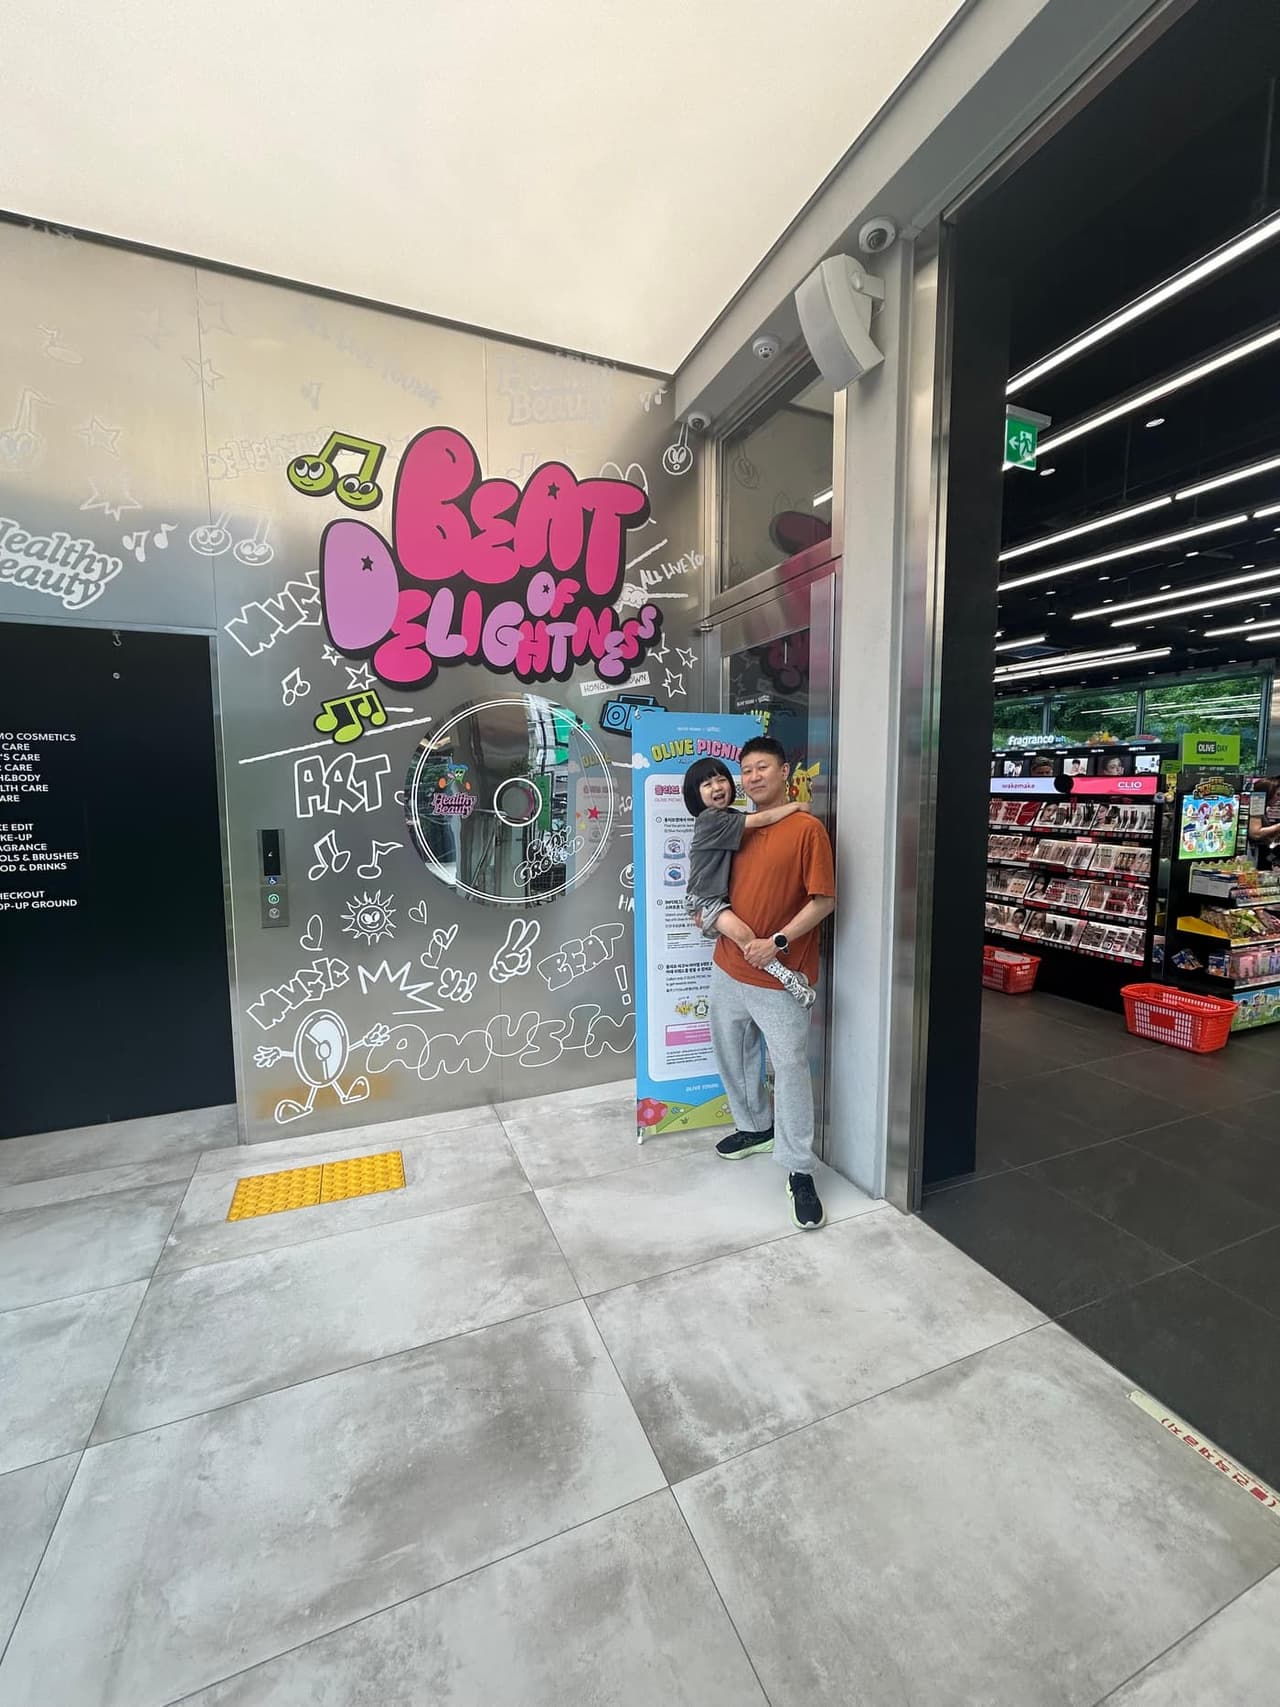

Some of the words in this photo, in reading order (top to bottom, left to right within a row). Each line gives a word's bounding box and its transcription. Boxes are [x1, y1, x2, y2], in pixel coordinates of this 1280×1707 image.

[396, 428, 649, 598] BEAT
[661, 557, 688, 579] LIVE
[526, 571, 581, 618] OF
[322, 519, 661, 685] DELIGHTNESS
[224, 570, 321, 656] MUS
[16, 732, 77, 742] COSMETICS
[651, 737, 694, 763] OLIVE
[1198, 743, 1216, 752] OLIVE
[12, 753, 41, 761] CARE
[4, 763, 33, 771] CARE
[20, 784, 49, 792] CARE
[294, 752, 391, 818] ART
[1117, 781, 1142, 789] CLIO
[11, 823, 34, 831] EDIT
[22, 853, 31, 862] &
[32, 852, 79, 861] BRUSHES
[19, 864, 28, 872] &
[29, 862, 68, 872] DRINKS
[0, 890, 46, 900] ECKOUT
[31, 899, 78, 909] GROUND
[537, 922, 625, 992] BEAT
[245, 957, 350, 1031] MUSIC
